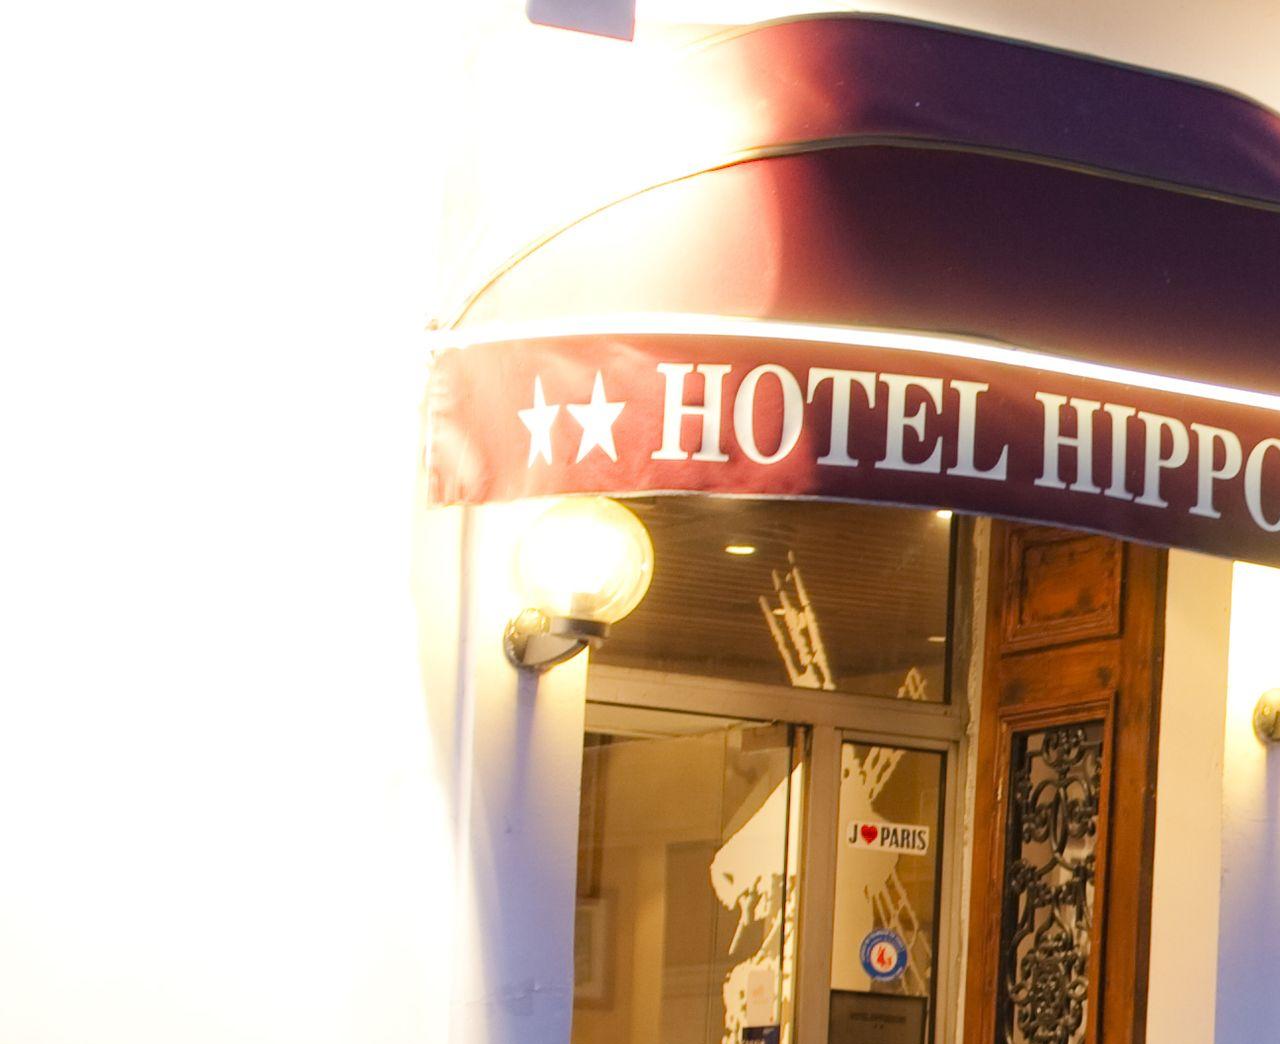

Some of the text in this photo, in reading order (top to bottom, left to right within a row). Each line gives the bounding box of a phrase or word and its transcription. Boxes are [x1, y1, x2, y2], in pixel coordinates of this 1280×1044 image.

[655, 362, 1007, 482] HOTEL
[849, 823, 927, 850] J PARIS
